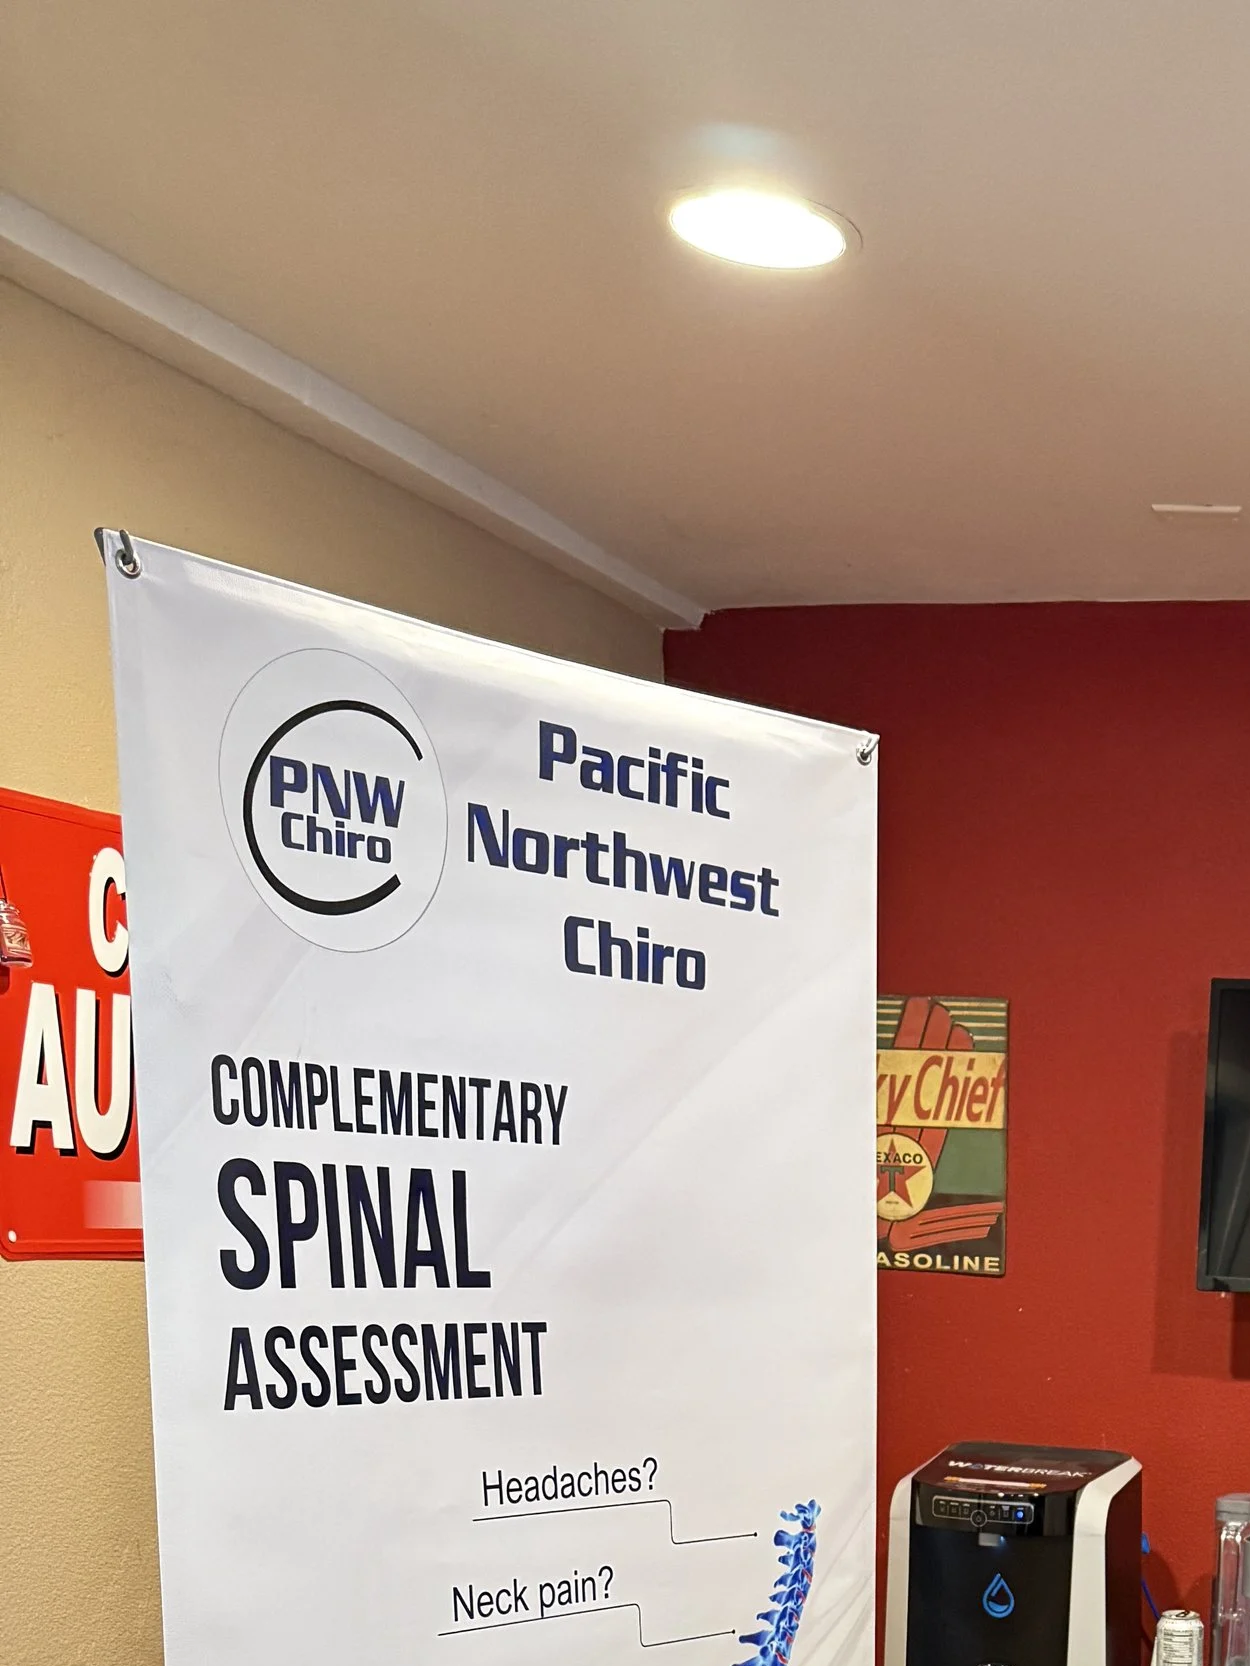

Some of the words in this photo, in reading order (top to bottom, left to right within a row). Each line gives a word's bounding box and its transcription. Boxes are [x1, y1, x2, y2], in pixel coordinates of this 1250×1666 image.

[269, 755, 405, 828] PNW
[540, 721, 731, 820] Pacific
[280, 812, 392, 865] Chiro
[467, 804, 781, 918] Northwest
[89, 847, 130, 976] C
[563, 915, 707, 992] Chiro
[10, 981, 134, 1155] AU
[211, 1054, 569, 1147] COMPLEMENTARY
[914, 1055, 1006, 1122] Chief
[877, 1152, 923, 1164] EXACO
[217, 1158, 492, 1291] SPINAL
[877, 1250, 1000, 1272] ASOLINE
[223, 1321, 548, 1412] ASSESSMENT
[481, 1457, 659, 1507] Headaches?
[451, 1578, 529, 1622] Neck
[538, 1565, 614, 1618] pain?
